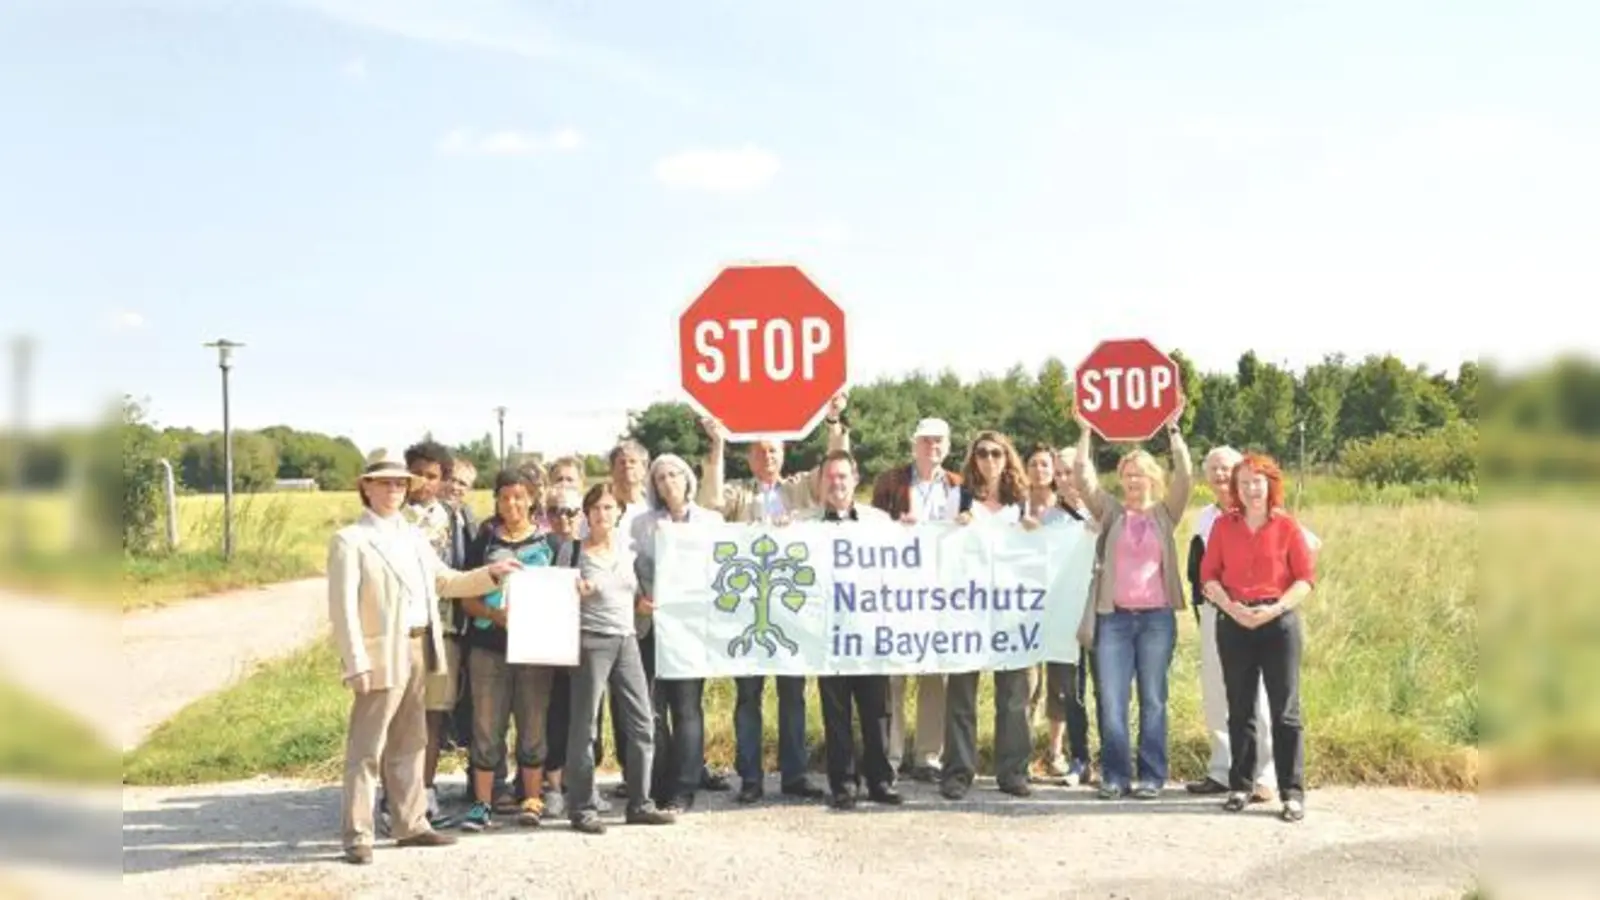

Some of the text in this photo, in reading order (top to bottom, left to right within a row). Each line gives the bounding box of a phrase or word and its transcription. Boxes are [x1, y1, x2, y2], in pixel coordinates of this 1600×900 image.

[694, 317, 831, 383] STOP
[1081, 365, 1173, 412] STOP
[833, 537, 921, 569] Bund
[833, 580, 1046, 613] Naturschutz
[832, 623, 1039, 663] in Bayern e.V.
